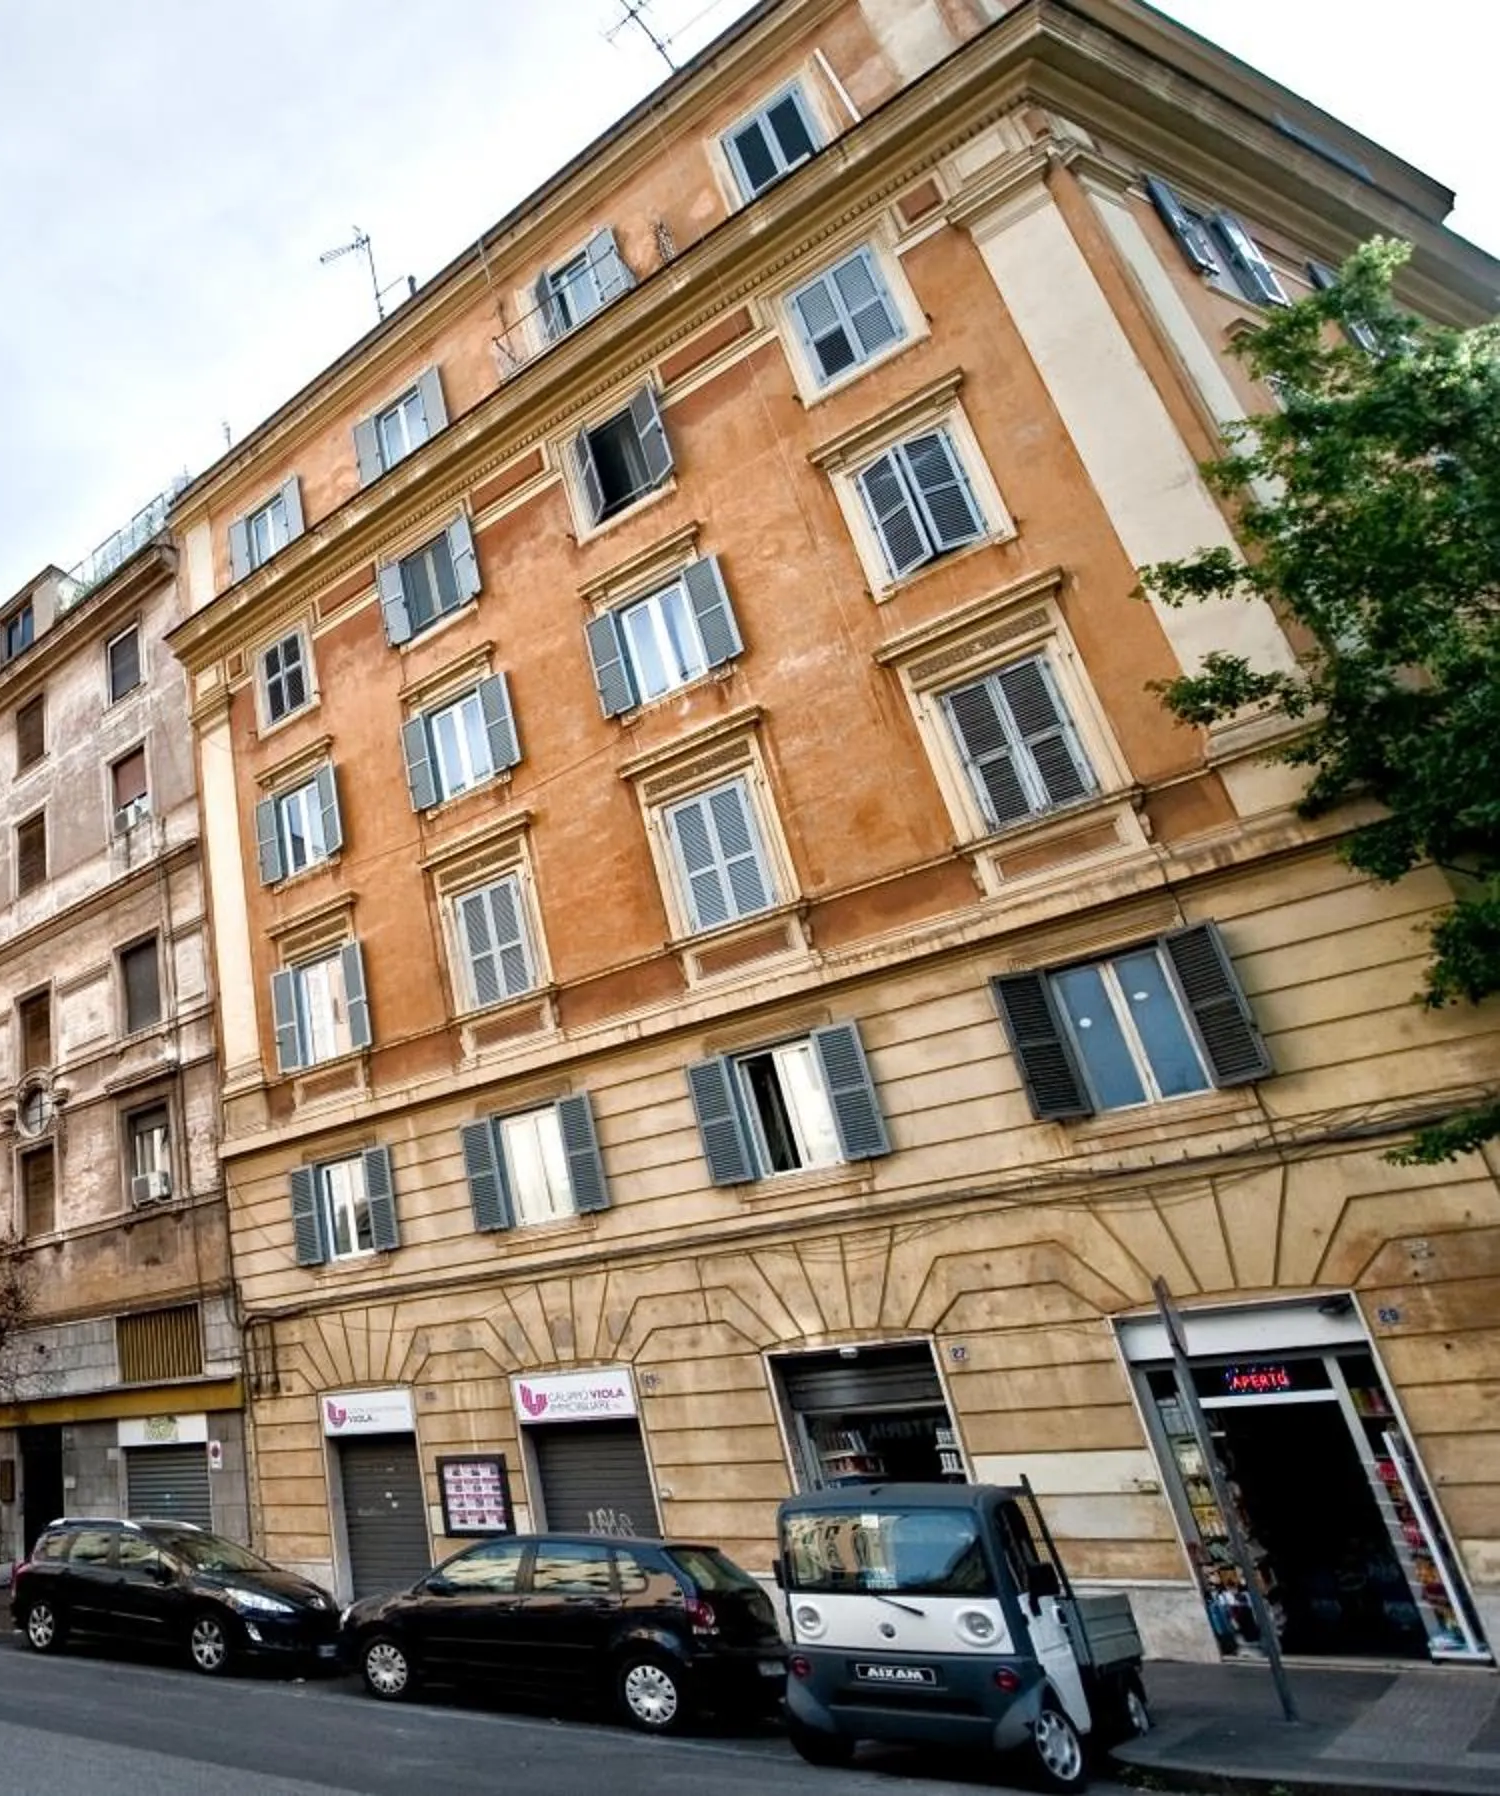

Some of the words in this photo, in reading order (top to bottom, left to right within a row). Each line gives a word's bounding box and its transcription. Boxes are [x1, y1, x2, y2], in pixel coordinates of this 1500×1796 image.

[1232, 1370, 1291, 1390] APERTO
[589, 1388, 626, 1401] VIOLA
[867, 1666, 924, 1681] AIXAM
